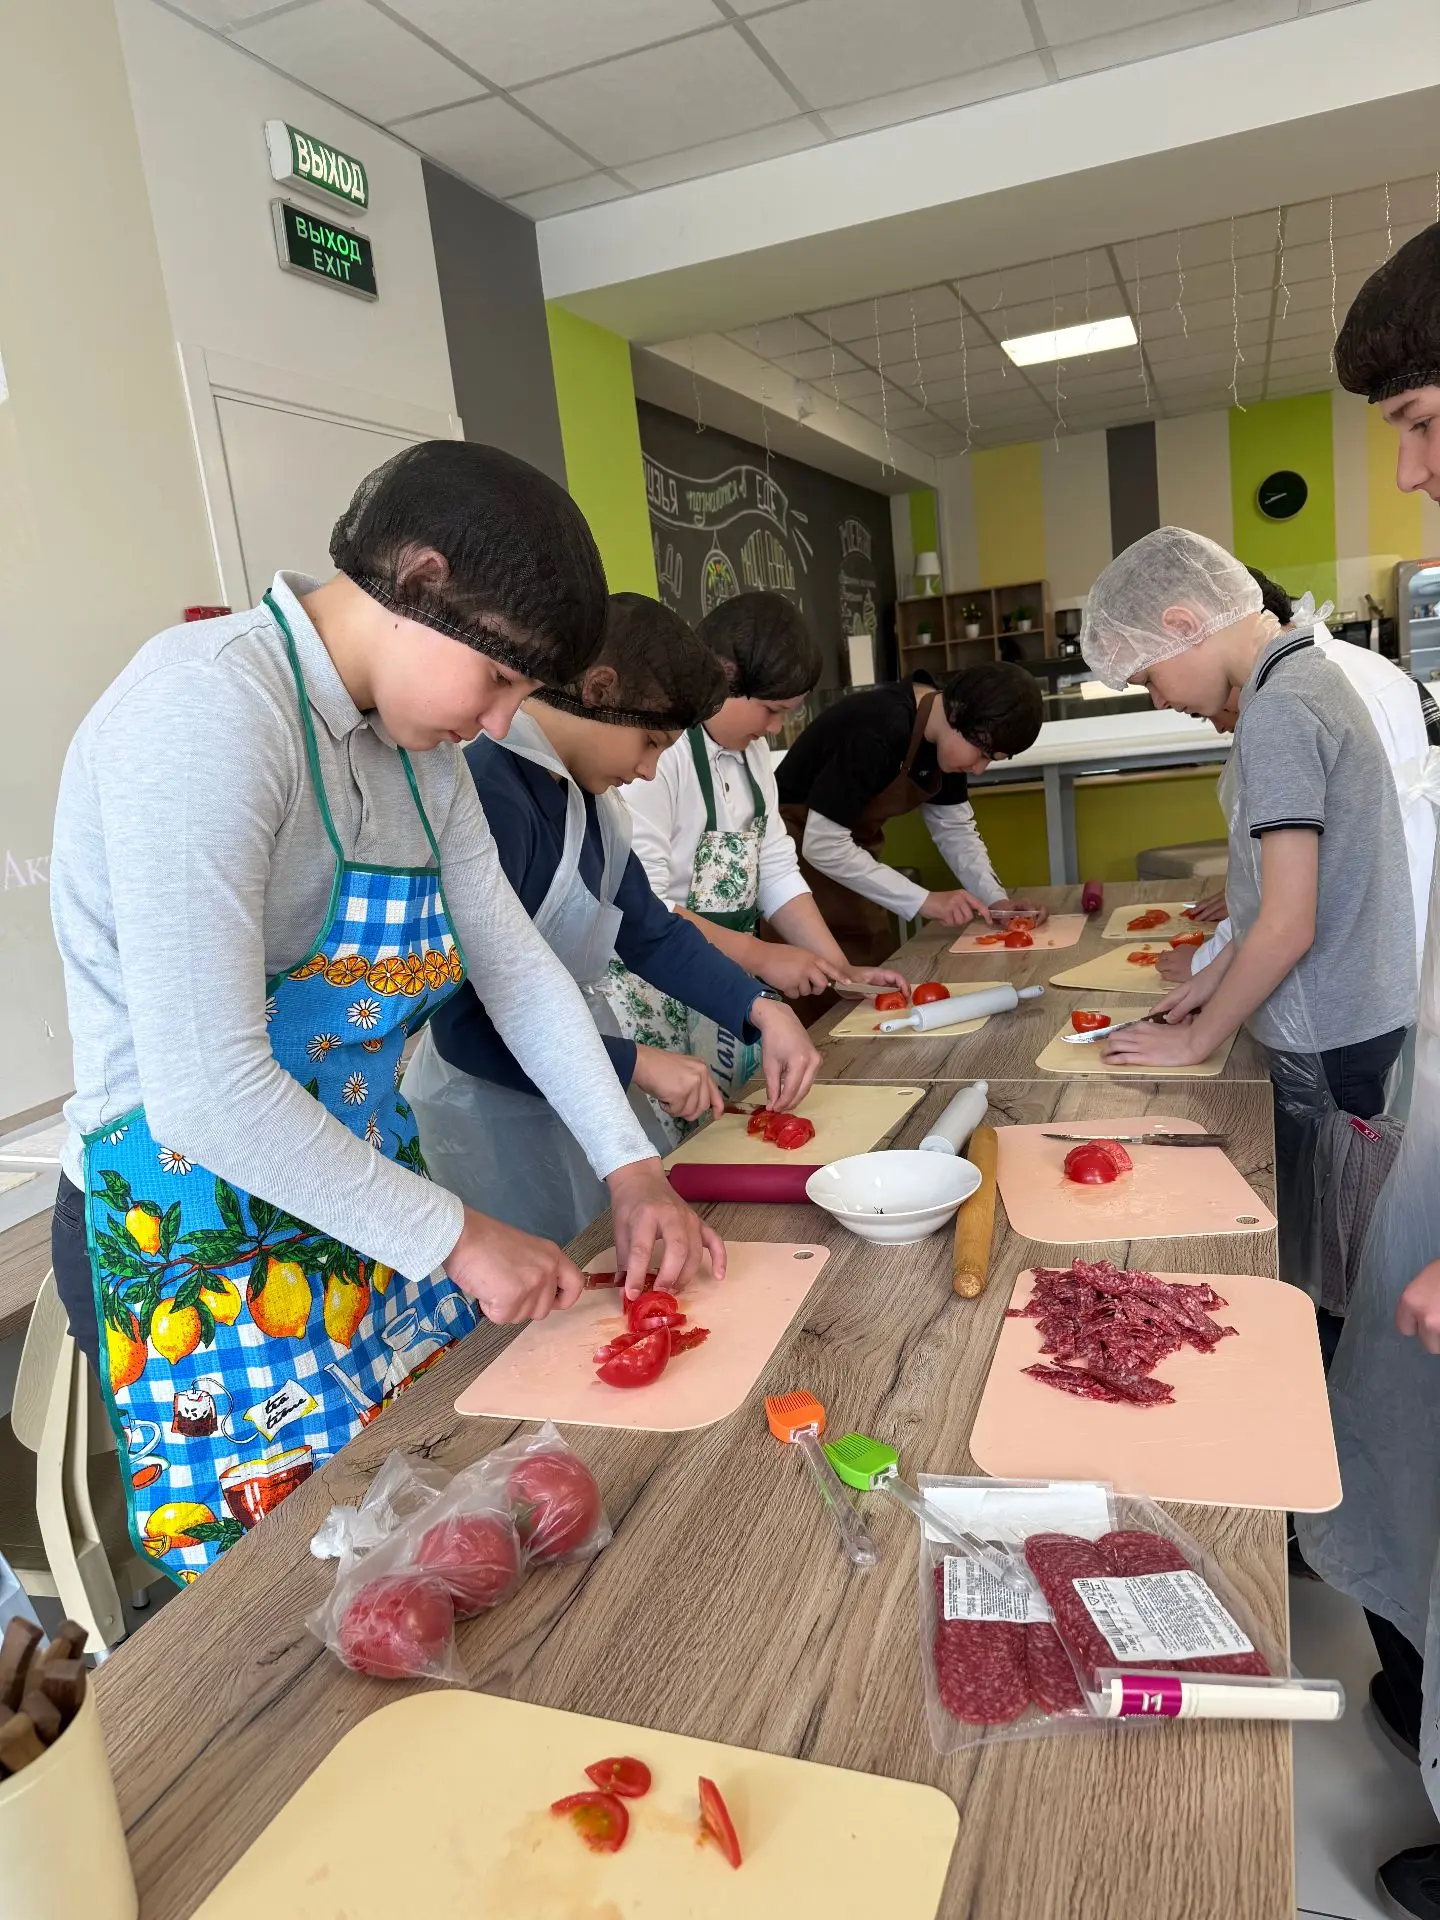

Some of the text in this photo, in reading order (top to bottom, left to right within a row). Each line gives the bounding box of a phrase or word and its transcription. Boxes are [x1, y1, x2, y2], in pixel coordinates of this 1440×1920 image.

[294, 132, 366, 204] ВЫХОД
[295, 216, 362, 266] ВЫХОД
[312, 248, 350, 281] EXIT
[643, 459, 679, 516] УЗЬЯ
[265, 1392, 289, 1414] tea
[266, 1398, 307, 1430] time
